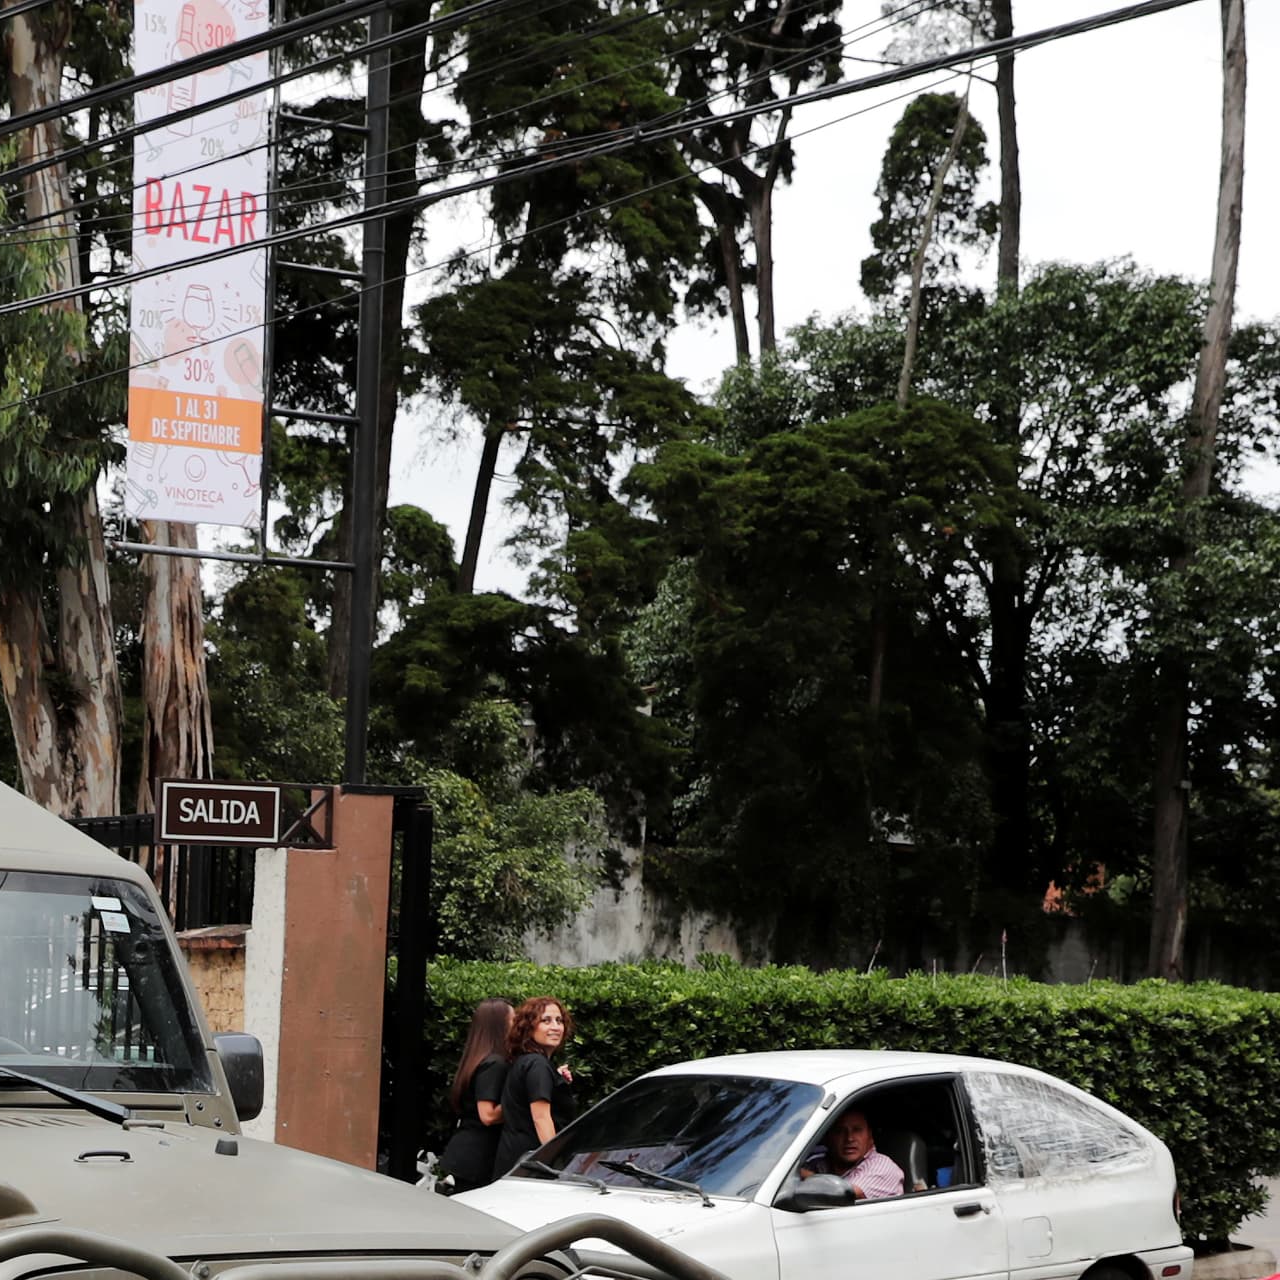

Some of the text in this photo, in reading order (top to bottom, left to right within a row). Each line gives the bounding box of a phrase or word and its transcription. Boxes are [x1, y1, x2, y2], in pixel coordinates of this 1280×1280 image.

[144, 13, 167, 34] 15%
[205, 23, 237, 49] 30%
[201, 137, 225, 158] 20%
[146, 177, 258, 247] BAZAR
[140, 309, 164, 330] 20%
[239, 304, 262, 325] 15%
[184, 357, 216, 385] 30%
[176, 397, 218, 420] 1 AL 31
[152, 418, 241, 447] DE SEPTIEMBRE
[164, 486, 225, 505] VINOTECA
[179, 798, 261, 825] SALIDA
